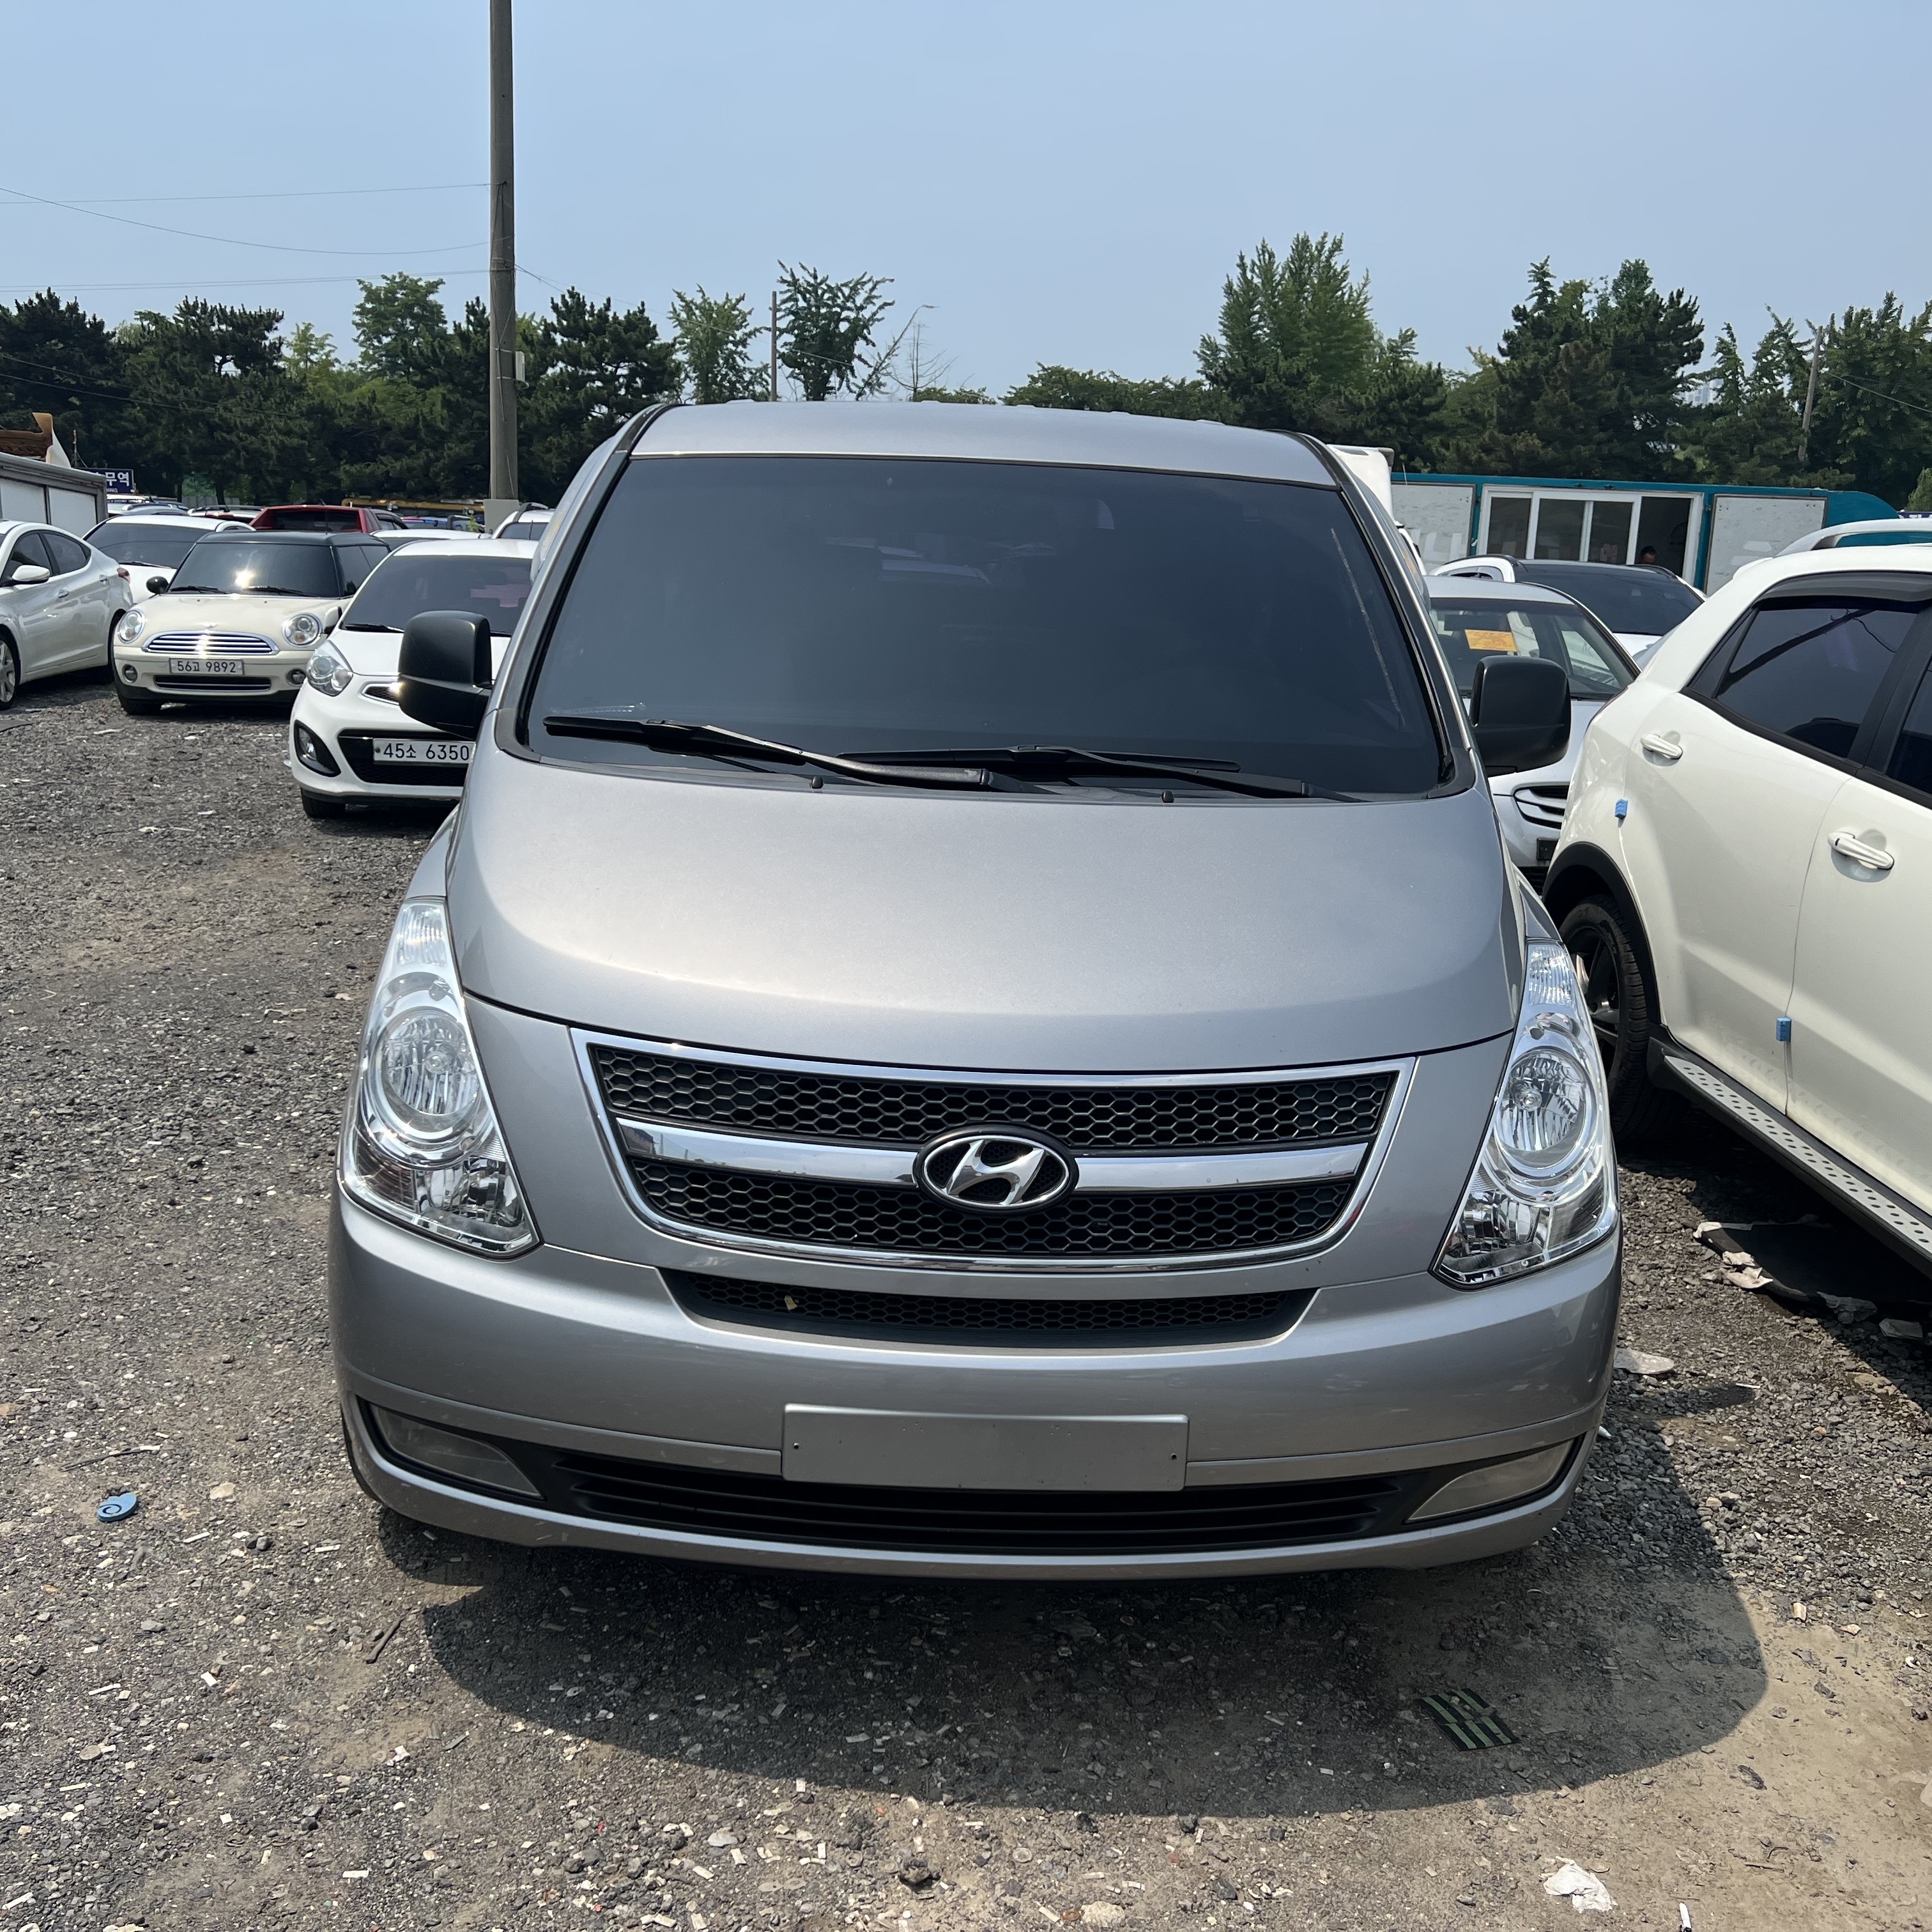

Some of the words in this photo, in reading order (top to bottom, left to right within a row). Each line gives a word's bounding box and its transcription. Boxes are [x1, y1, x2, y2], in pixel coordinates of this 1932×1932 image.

[96, 471, 130, 487] 무역
[177, 661, 200, 671] 56고
[205, 661, 236, 673] 9892
[383, 742, 417, 759] 45소
[425, 744, 470, 761] 6350
